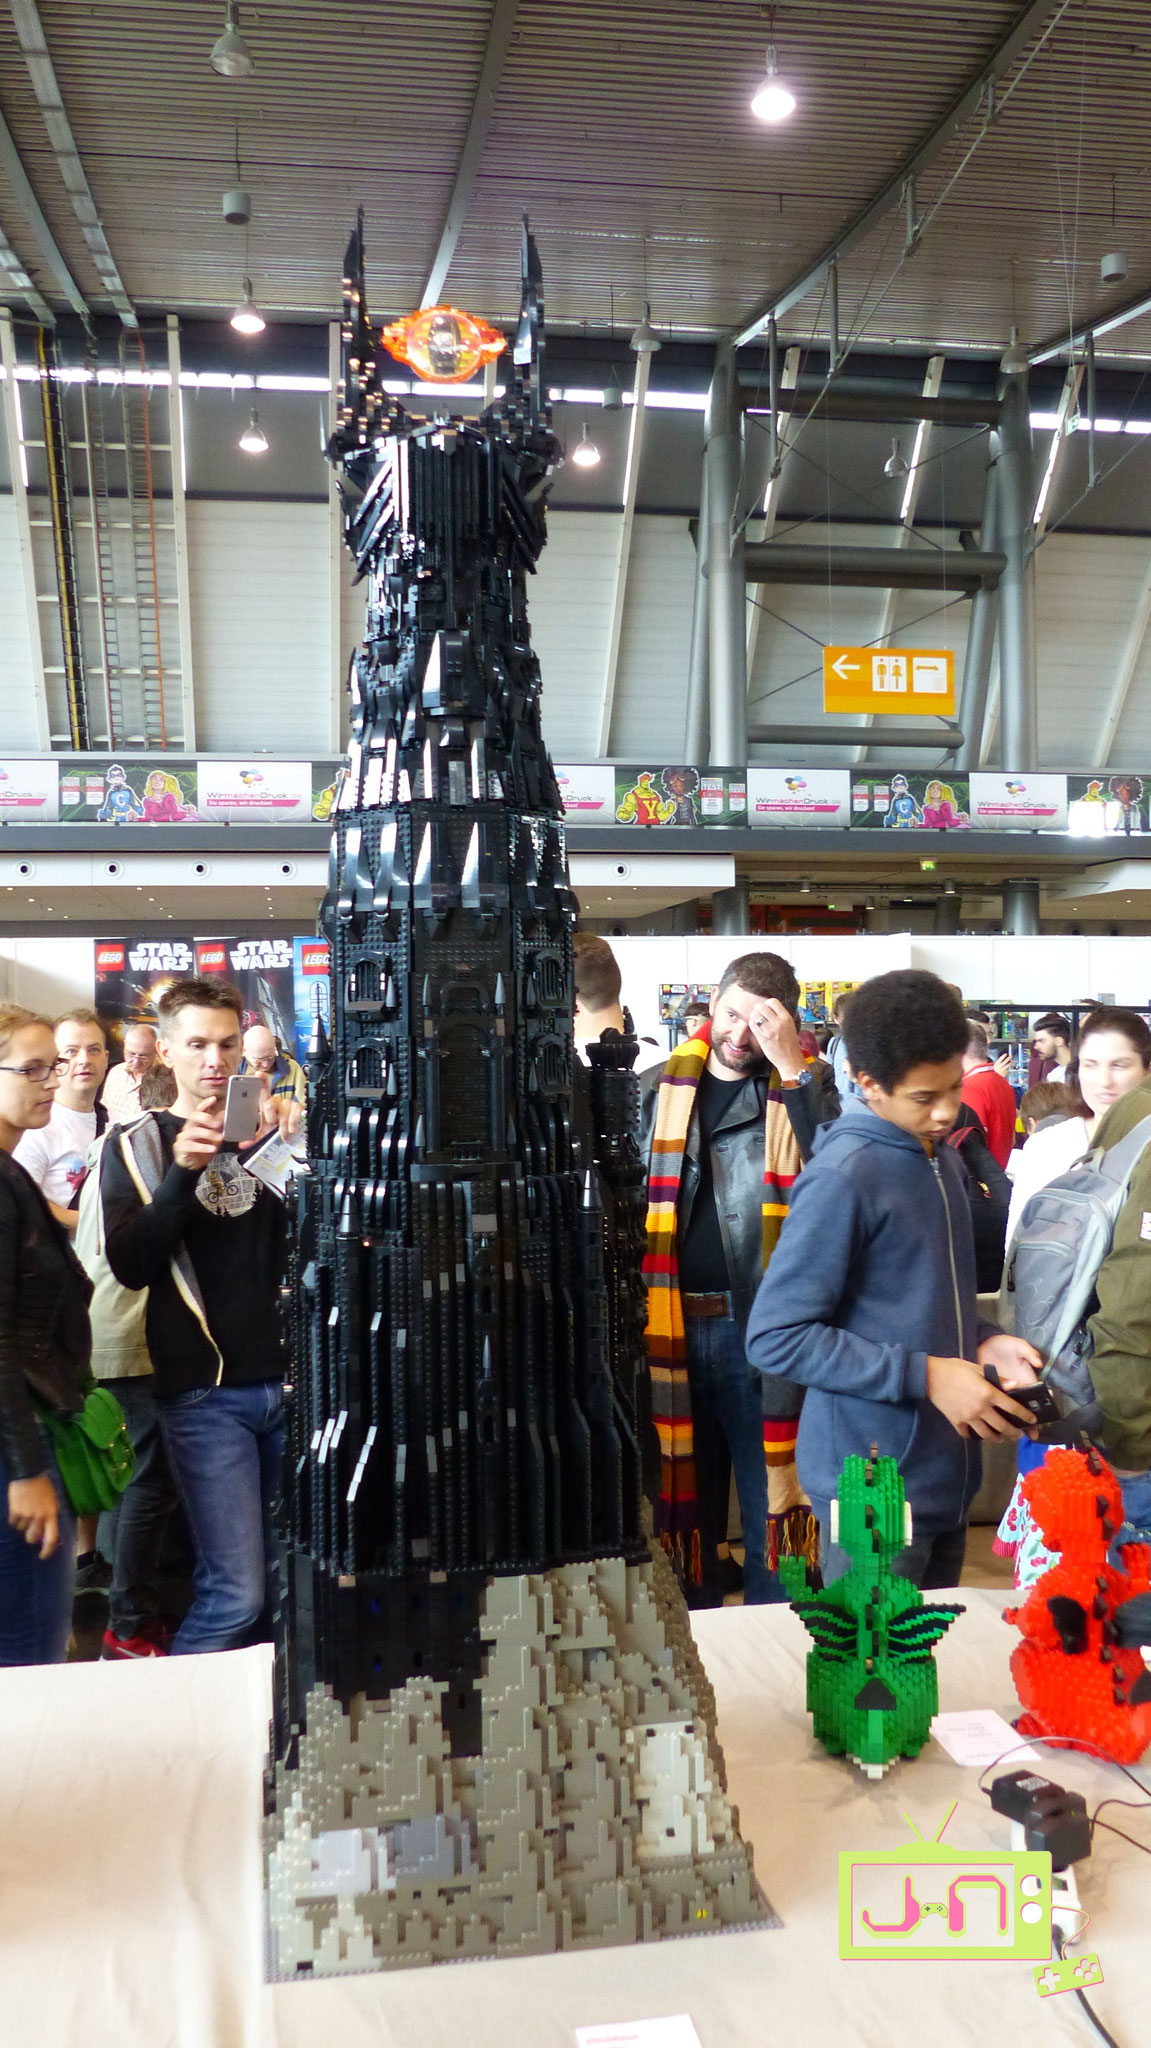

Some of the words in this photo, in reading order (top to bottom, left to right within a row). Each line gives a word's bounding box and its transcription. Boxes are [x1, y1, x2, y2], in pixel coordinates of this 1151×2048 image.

[116, 793, 126, 806] C
[642, 799, 659, 819] Y
[899, 801, 909, 813] C
[129, 943, 192, 957] STAR
[230, 940, 293, 957] STAR
[98, 952, 123, 964] LEGO
[129, 956, 192, 971] WARS
[200, 952, 224, 964] LEGO
[230, 954, 294, 970] WARS
